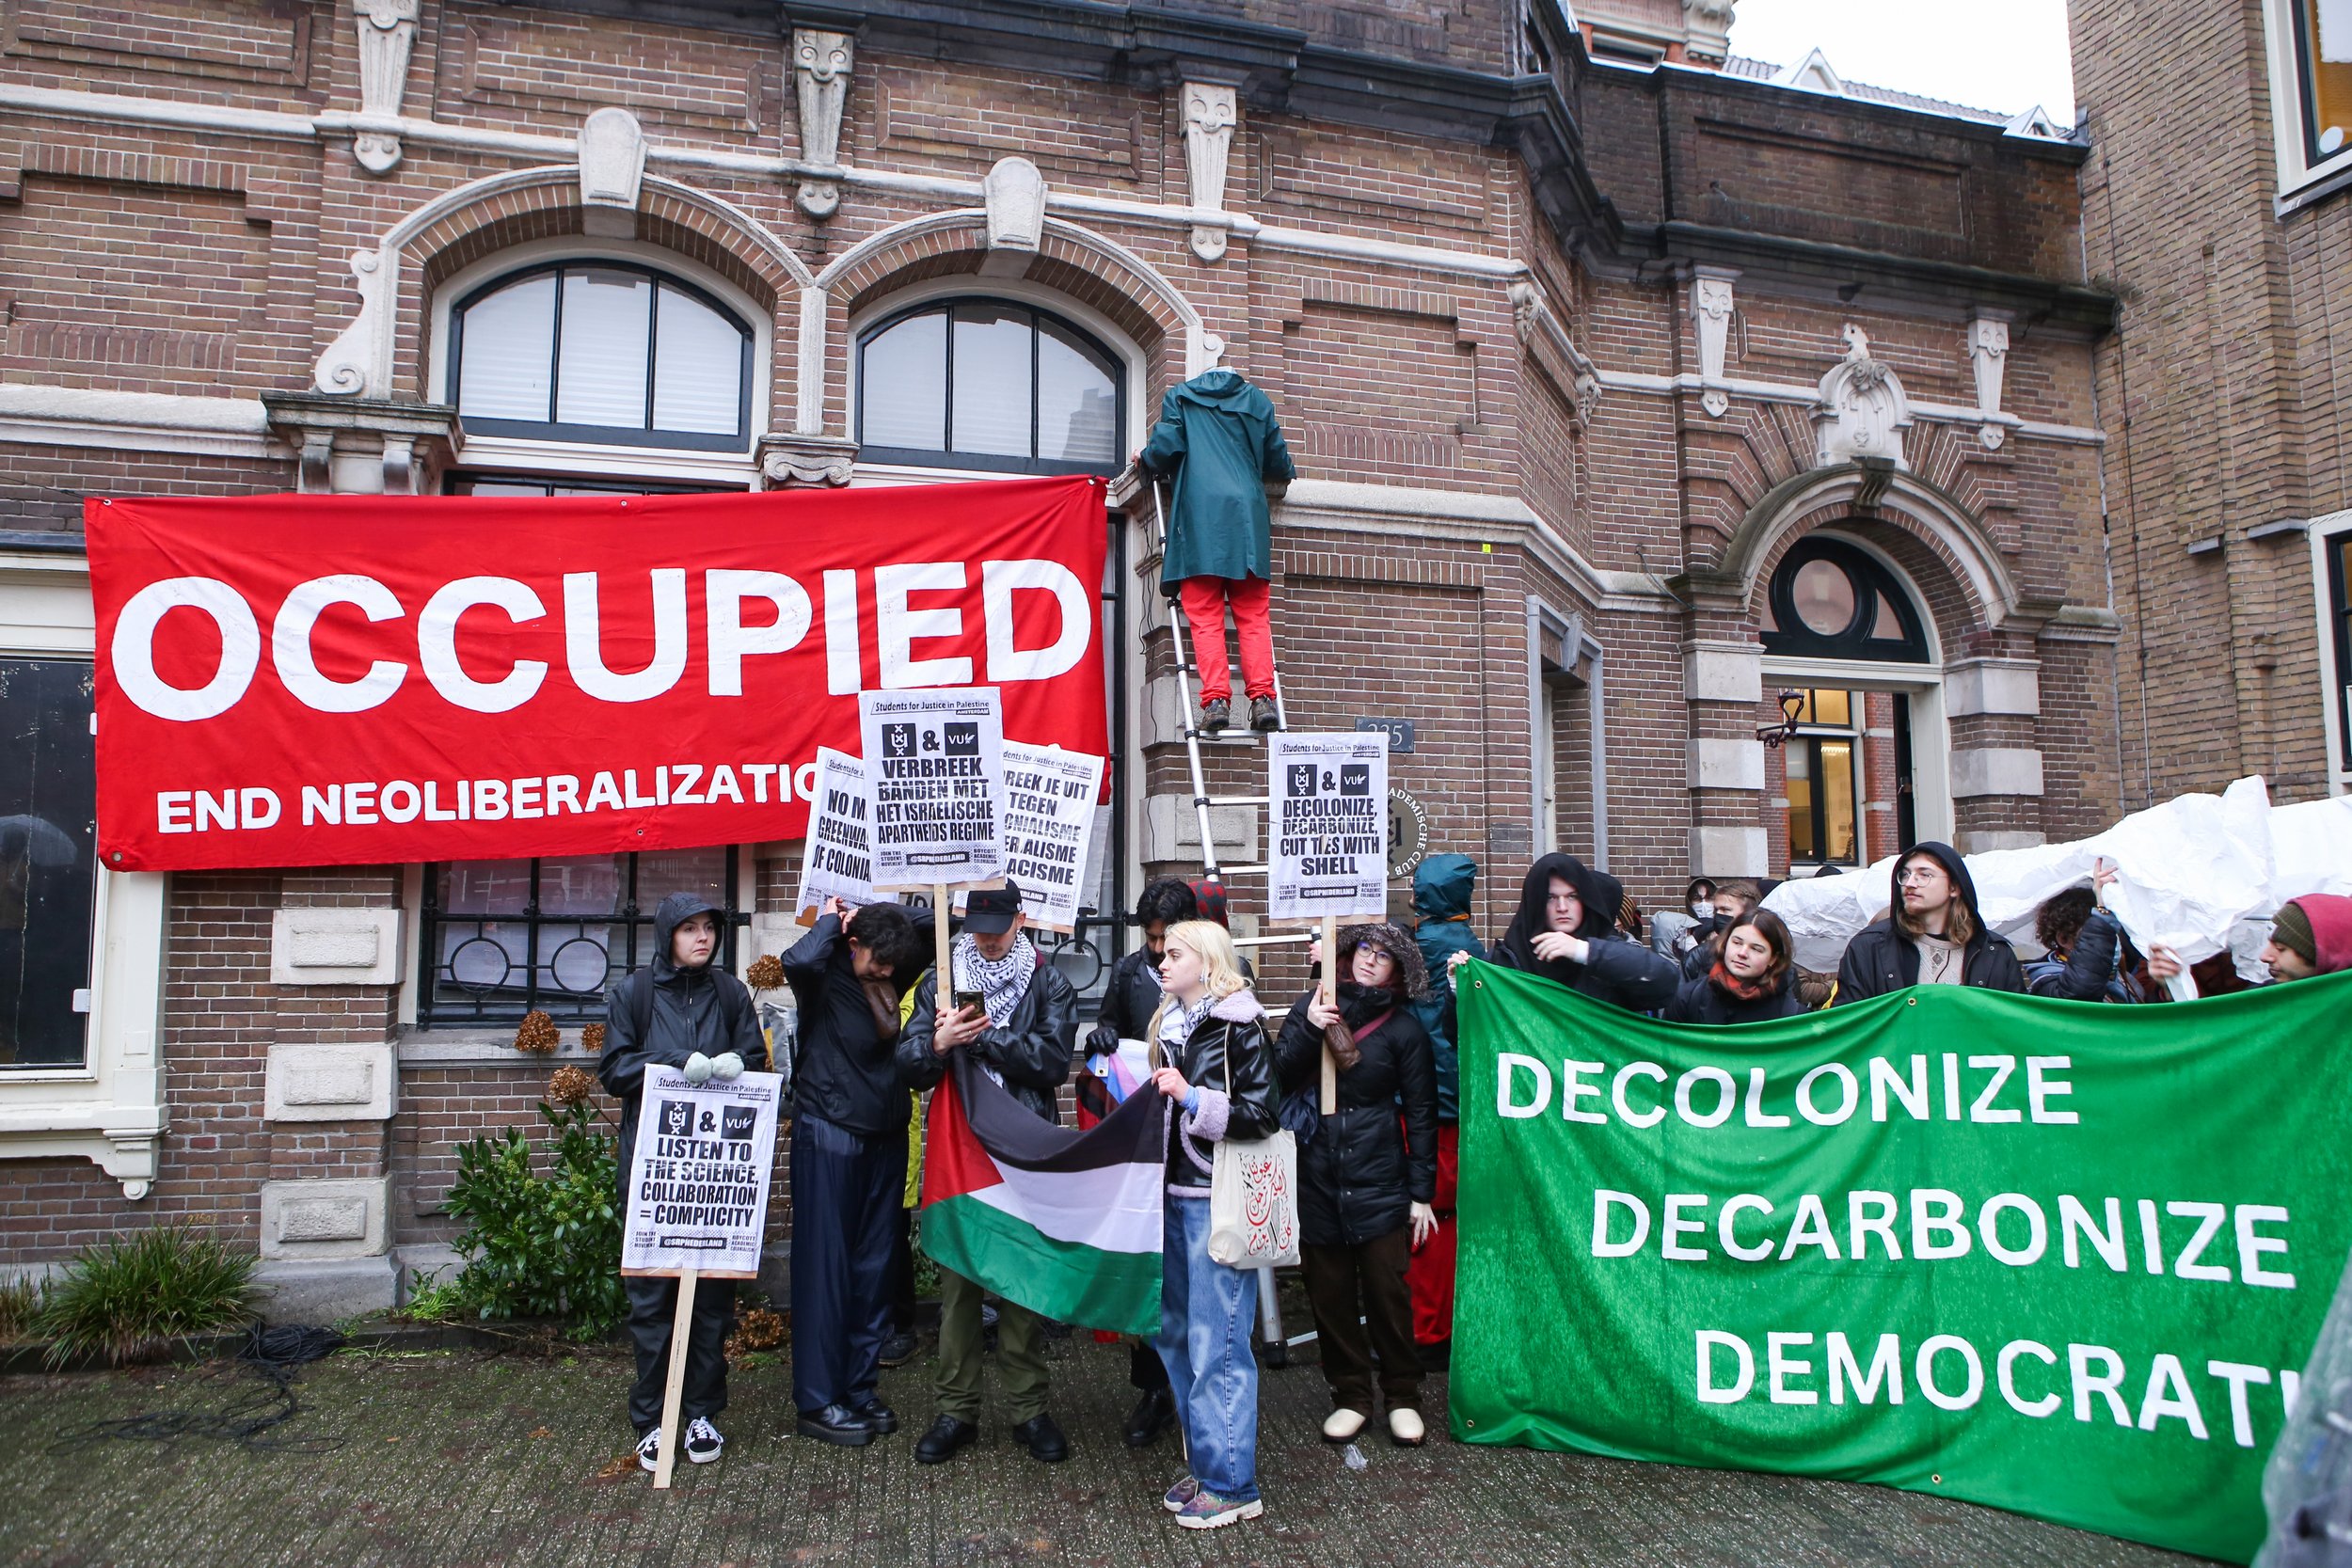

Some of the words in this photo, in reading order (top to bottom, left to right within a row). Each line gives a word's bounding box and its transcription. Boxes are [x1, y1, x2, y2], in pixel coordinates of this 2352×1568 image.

[111, 559, 1092, 721] OCCUPIED
[875, 702, 907, 712] Students
[909, 701, 919, 710] for
[921, 701, 946, 710] Justice
[922, 729, 940, 752] &
[947, 735, 964, 744] VU
[1282, 743, 1311, 752] Students
[829, 759, 851, 773] Students
[882, 756, 982, 778] VERBREEK
[1023, 752, 1032, 762] for
[1033, 755, 1055, 766] Justice
[1056, 758, 1062, 768] in
[1063, 761, 1093, 772] Palestine
[877, 782, 949, 801] BANDEN
[953, 779, 989, 800] MET
[1003, 769, 1041, 791] REEK
[1044, 777, 1060, 796] JE
[1063, 781, 1089, 800] UIT
[1322, 771, 1336, 791] &
[1343, 776, 1358, 785] VU
[157, 786, 281, 833] END
[828, 788, 850, 816] NO
[851, 796, 868, 821] M
[877, 803, 901, 823] HET
[905, 800, 993, 821] ISRAELISCHE
[1009, 791, 1057, 816] TEGEN
[1282, 798, 1377, 818] DECOLONIZE,
[818, 816, 869, 852] GREENWA
[949, 821, 994, 841] REGIME
[1282, 817, 1378, 835] DECARBONIZE,
[1279, 838, 1307, 857] CUT
[1343, 836, 1380, 854] WITH
[1005, 858, 1073, 885] ACISME
[1301, 857, 1359, 876] SHELL
[1394, 851, 1422, 876] CLUB
[659, 1077, 691, 1089] Students
[704, 1082, 730, 1091] Justice
[731, 1083, 738, 1092] in
[1496, 1052, 2080, 1128] DECOLONIZE
[699, 1111, 716, 1132] &
[725, 1117, 742, 1129] VU
[657, 1137, 723, 1160] LISTEN
[728, 1142, 753, 1162] TO
[644, 1158, 676, 1180] THE
[681, 1161, 759, 1186] SCIENCE,
[641, 1181, 757, 1206] COLLABORATION
[654, 1205, 755, 1227] COMPLICITY
[1591, 1187, 2296, 1290] DECARBONIZE
